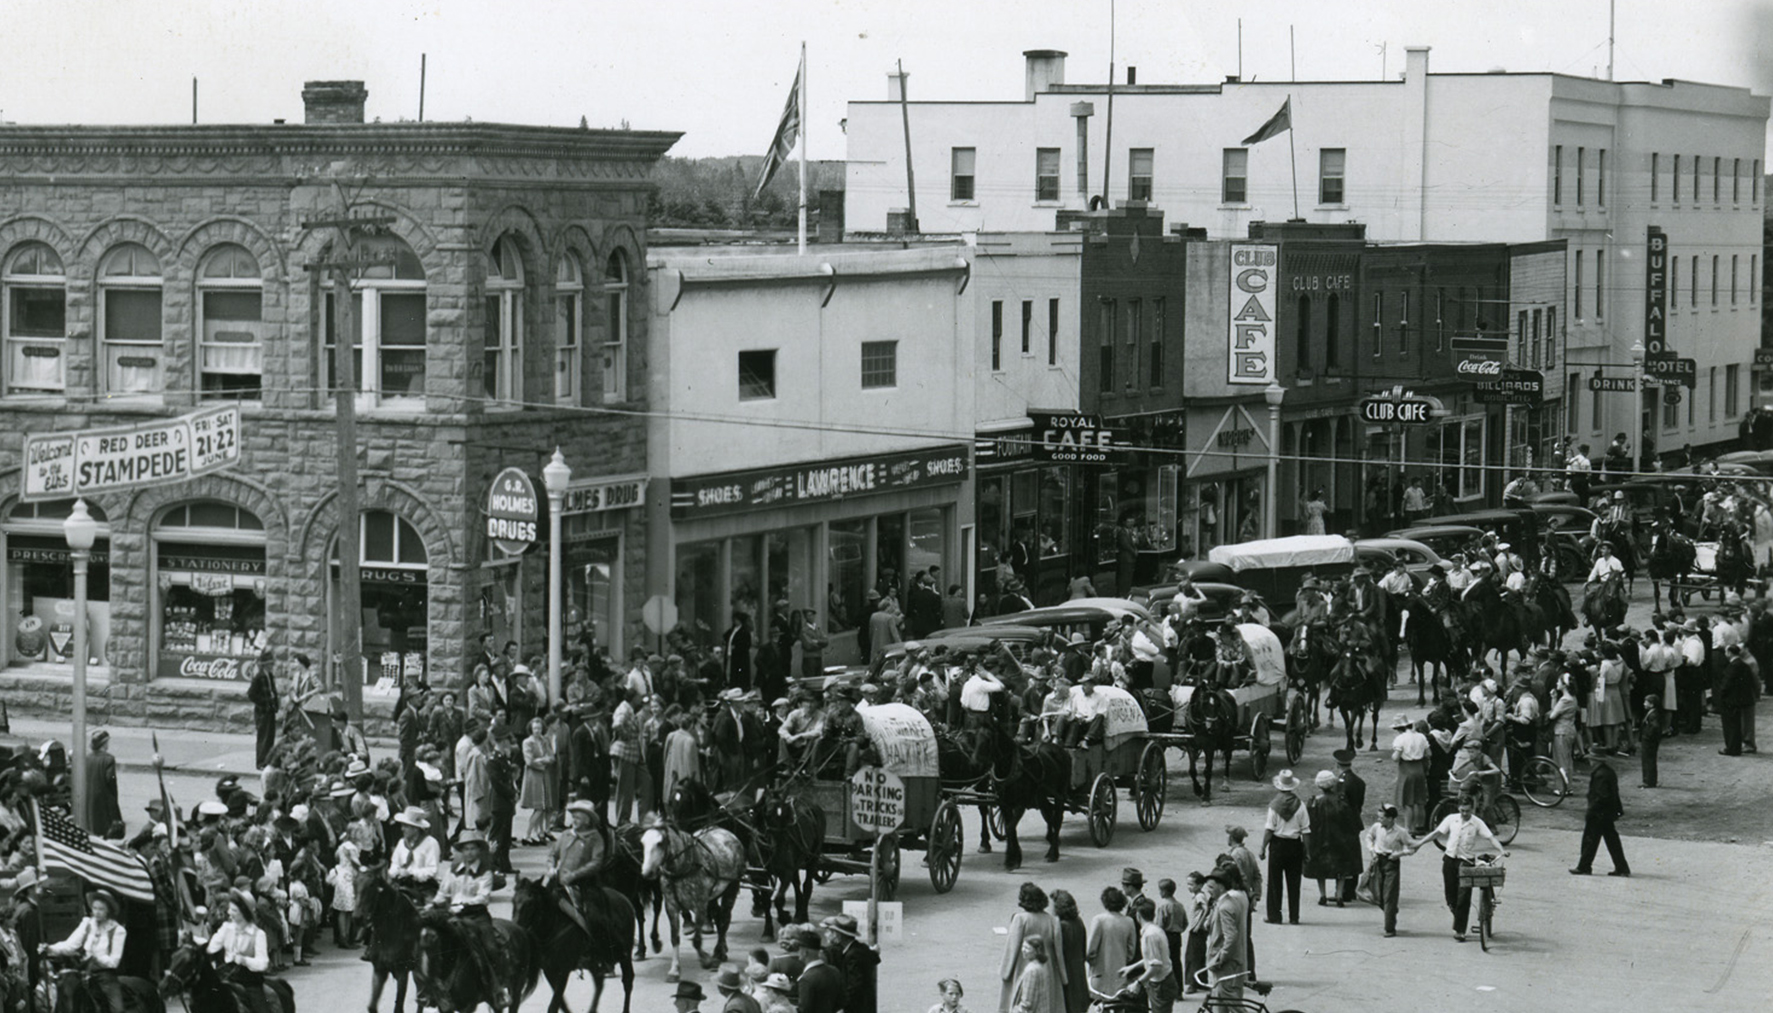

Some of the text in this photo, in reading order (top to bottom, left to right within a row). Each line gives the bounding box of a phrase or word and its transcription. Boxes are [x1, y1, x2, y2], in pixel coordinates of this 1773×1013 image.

[1234, 250, 1276, 267] CLUB
[1292, 275, 1350, 291] CLUB CAFE
[1649, 237, 1663, 354] BUFFALO
[1233, 268, 1272, 378] CAFE
[1457, 360, 1501, 374] Coca-Cola
[1647, 361, 1693, 373] HOTEL
[1477, 381, 1539, 391] BILLIARDS
[1366, 402, 1427, 421] CLUB CAFE
[1050, 417, 1095, 429] ROYAL
[99, 432, 169, 455] RED DEER
[997, 432, 1033, 458] FOUNTAIN
[1043, 430, 1113, 452] CAFE
[31, 442, 73, 465] Welcome
[201, 450, 229, 466] JUNE
[1051, 453, 1106, 461] GOOD FOOD
[50, 463, 61, 476] the
[78, 449, 187, 487] STAMPEDE
[504, 479, 526, 493] G.R.
[697, 457, 964, 507] SHOES LAWRENCE SHOES
[606, 483, 639, 507] DRUG
[492, 494, 534, 514] HOLMES
[487, 518, 537, 542] DRUGS
[167, 559, 261, 572] STATIONERY
[361, 569, 416, 582] RUGS
[180, 655, 239, 679] Coca-Cola
[865, 771, 887, 784] NO
[852, 783, 903, 801] PARKING
[857, 813, 896, 828] TRAILERS
